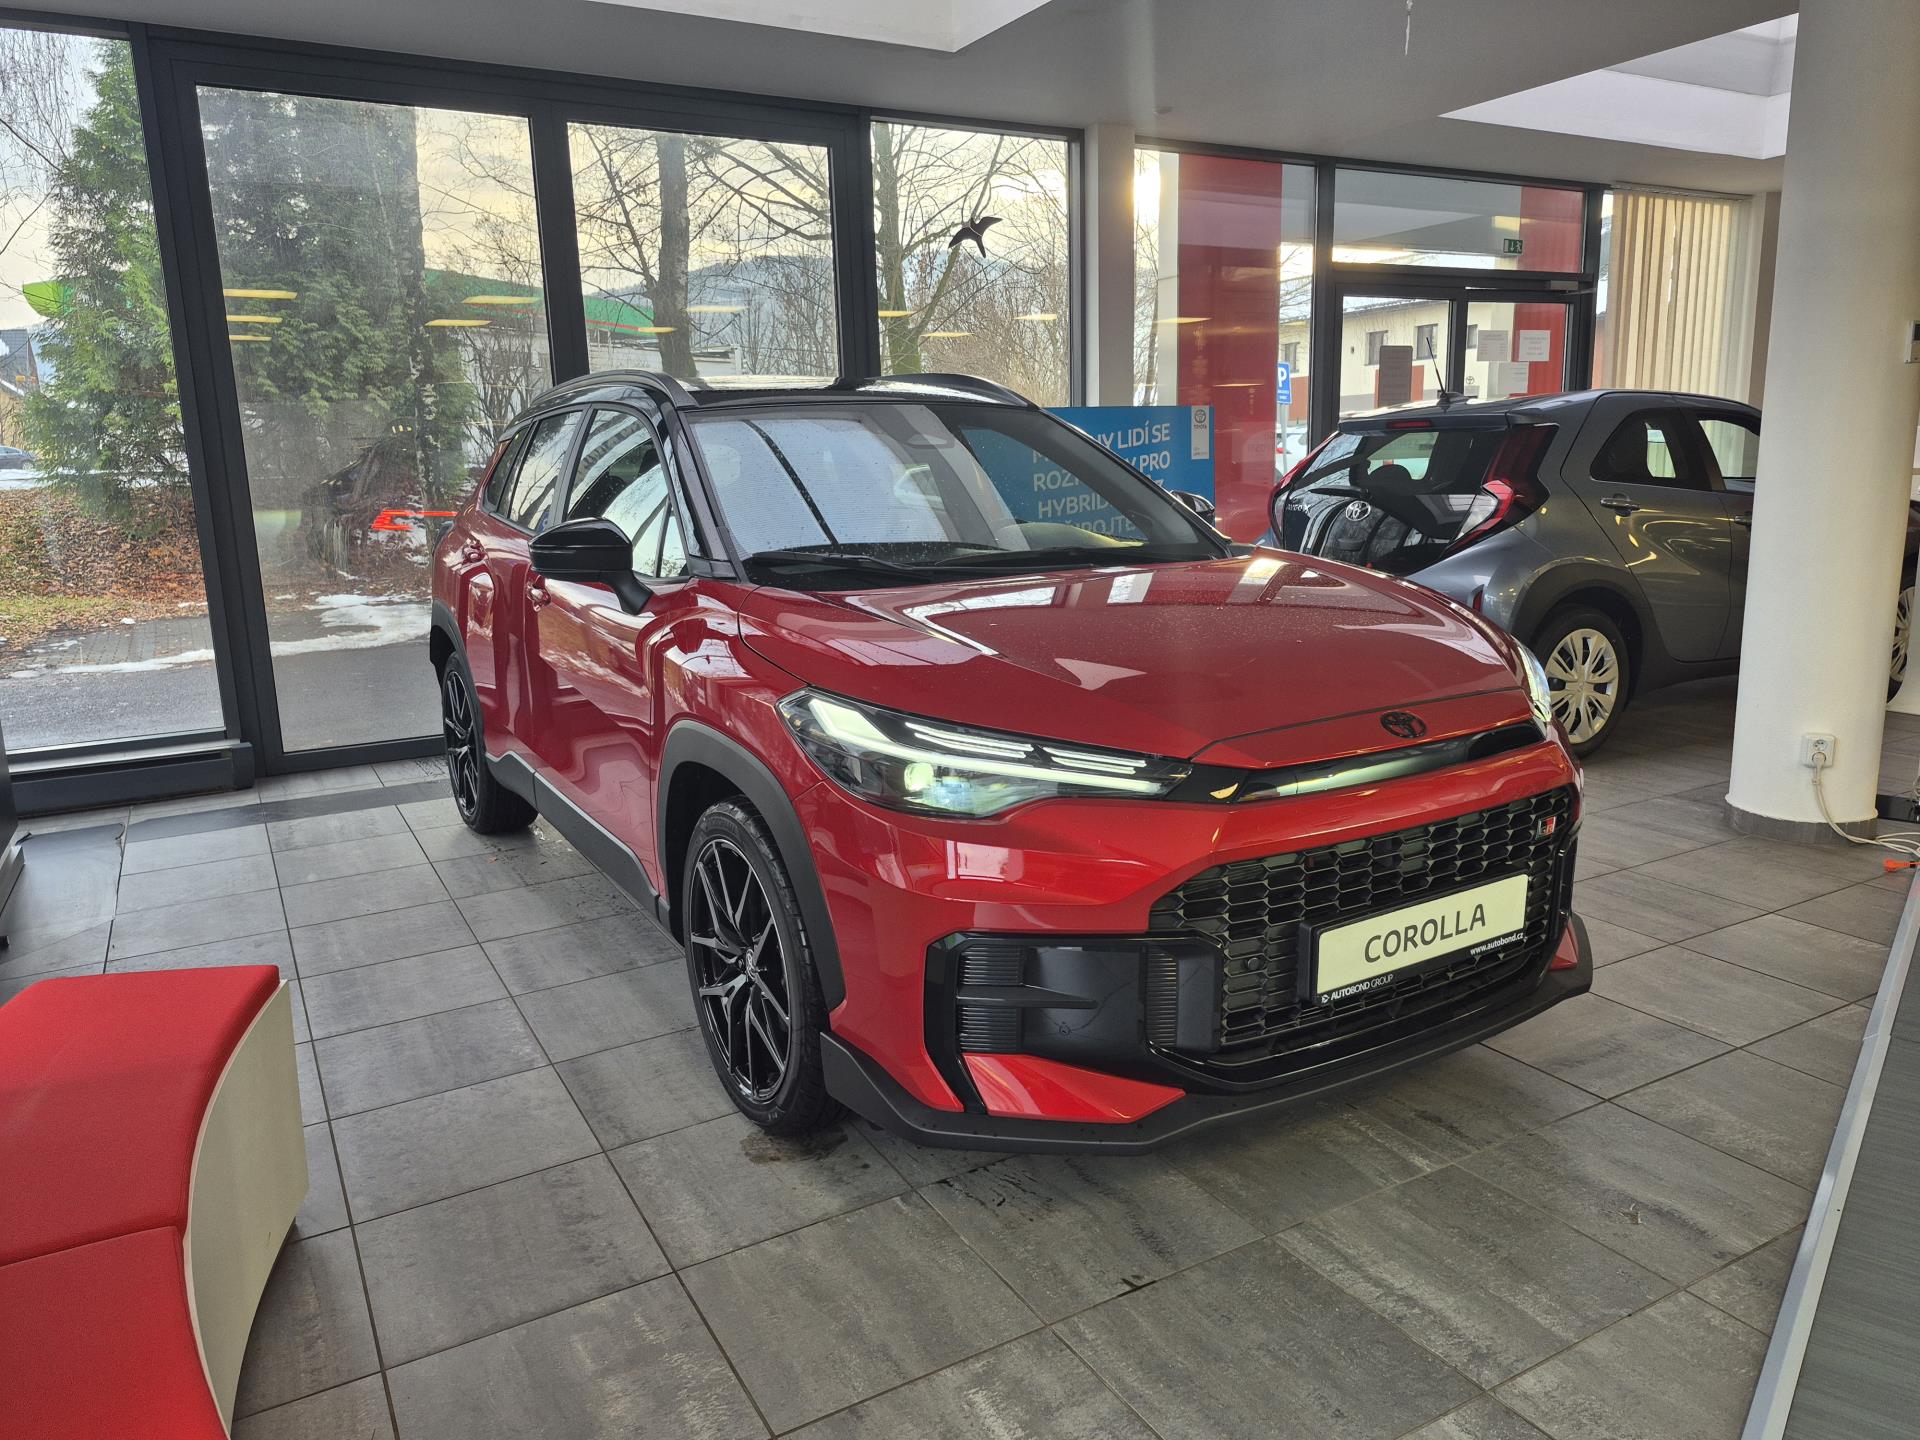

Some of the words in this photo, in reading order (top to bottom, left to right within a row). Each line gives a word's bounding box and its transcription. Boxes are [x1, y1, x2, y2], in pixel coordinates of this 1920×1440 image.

[1277, 367, 1287, 388] P
[1117, 420, 1149, 449] LIDÍ
[1151, 423, 1170, 444] SE
[1139, 450, 1170, 473] PRO
[1364, 903, 1486, 963] COROLLA
[1470, 932, 1524, 956] www.autobond.cz
[1330, 981, 1371, 1001] AUTOBOND
[1370, 973, 1394, 988] GROUP
